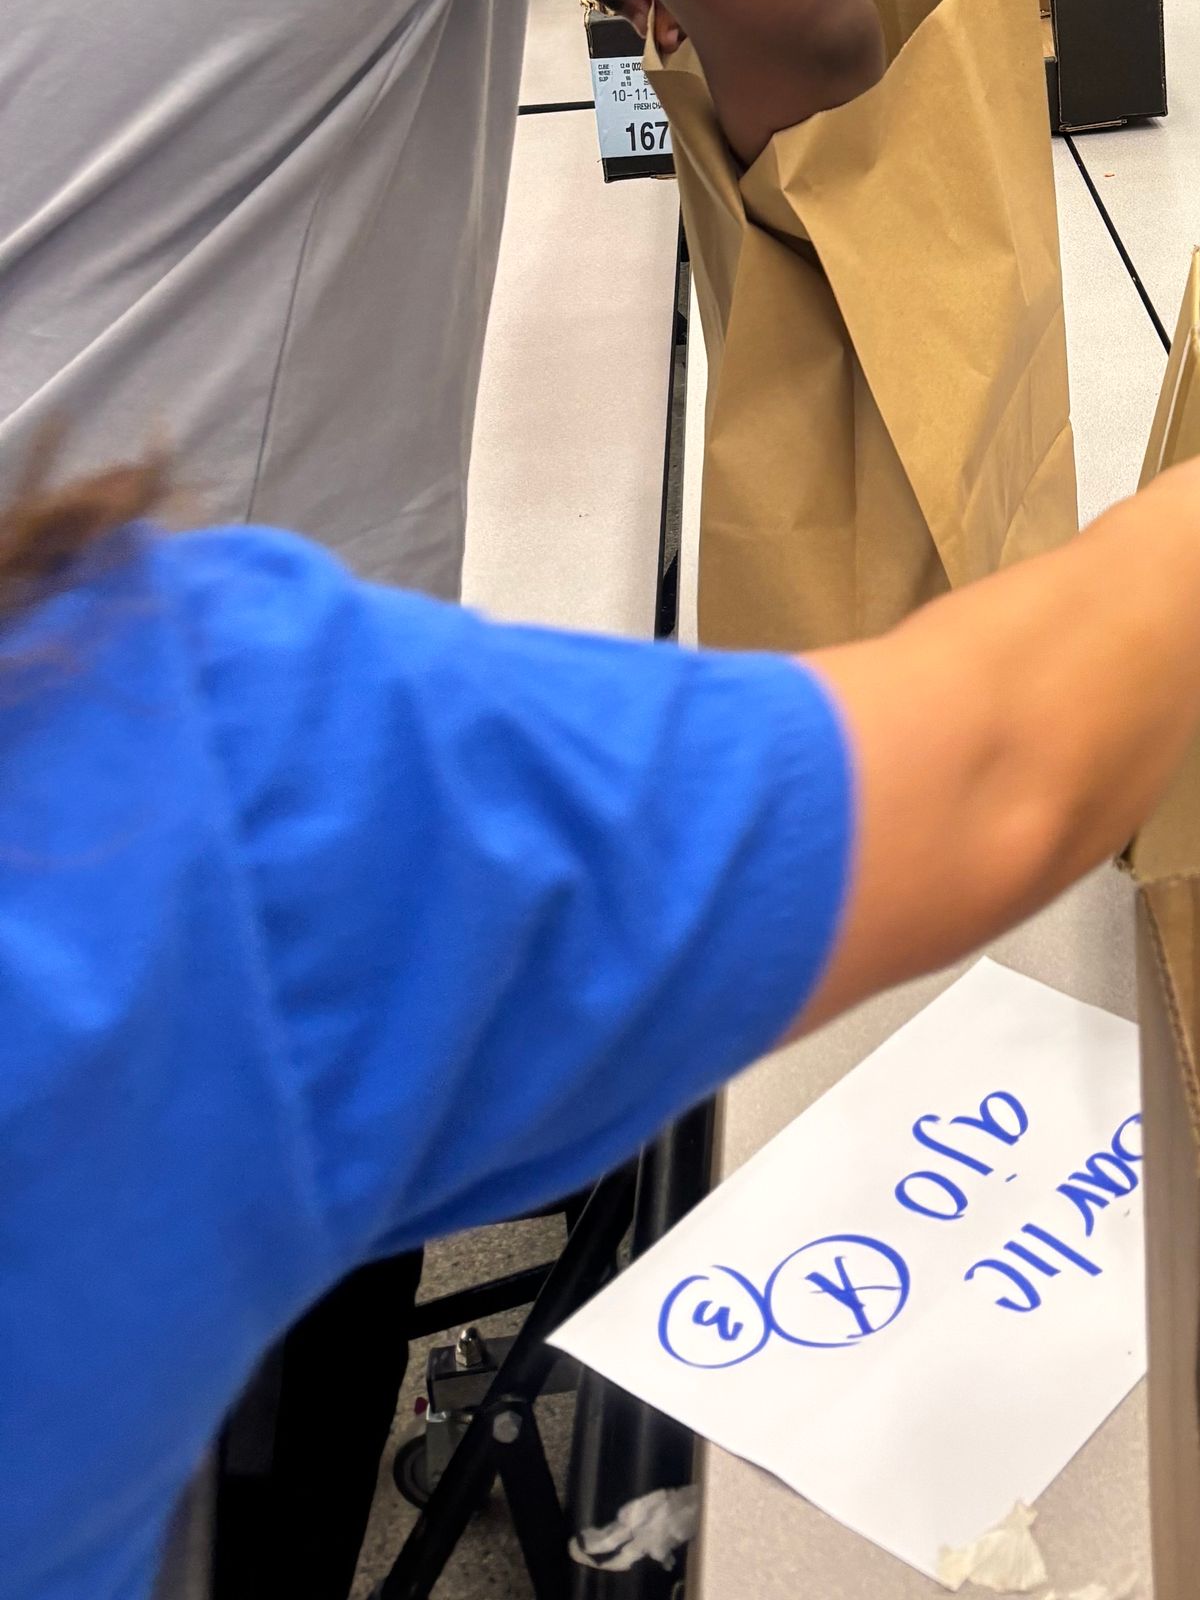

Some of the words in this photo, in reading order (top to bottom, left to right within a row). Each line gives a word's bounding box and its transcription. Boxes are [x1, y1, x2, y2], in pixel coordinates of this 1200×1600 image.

[633, 102, 652, 111] FRESH
[625, 121, 669, 152] 167
[893, 1090, 1029, 1221] ajo
[692, 1300, 744, 1342] 3
